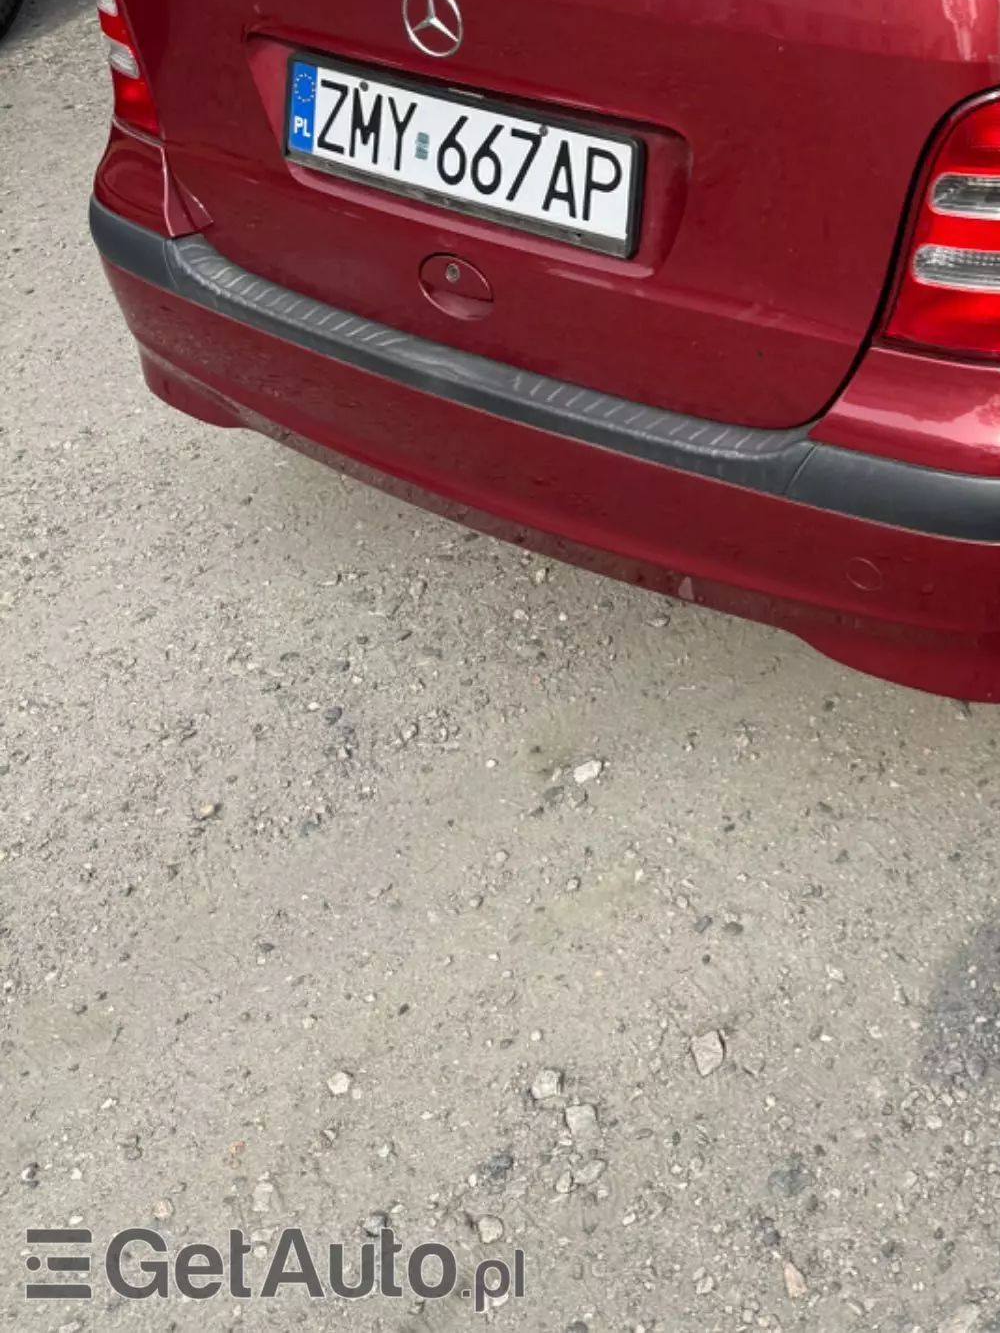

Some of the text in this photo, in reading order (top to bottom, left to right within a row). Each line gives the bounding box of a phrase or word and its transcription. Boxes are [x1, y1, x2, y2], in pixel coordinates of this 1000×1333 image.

[294, 116, 311, 138] PL
[317, 79, 622, 222] ZMY 667AP
